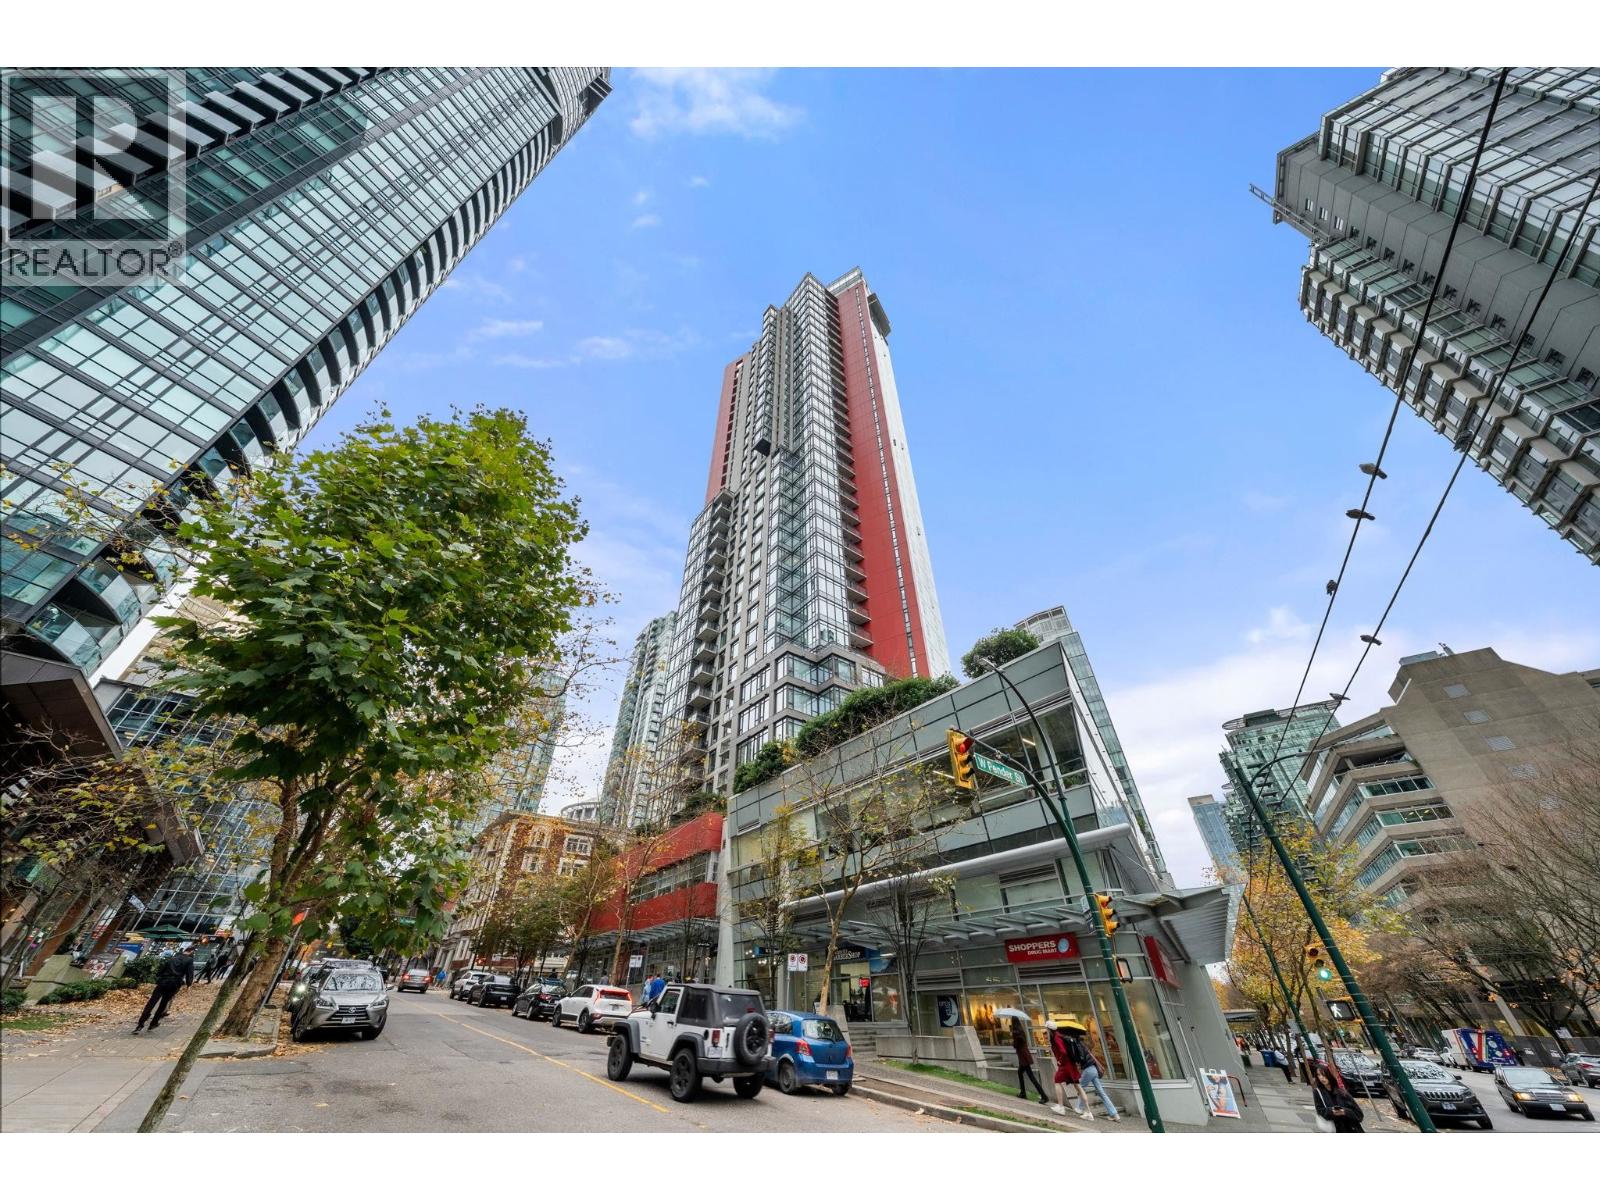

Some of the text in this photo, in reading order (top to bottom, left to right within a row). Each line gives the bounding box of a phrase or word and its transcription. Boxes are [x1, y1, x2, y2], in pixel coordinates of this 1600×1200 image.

[977, 756, 986, 769] W
[987, 760, 1013, 780] Pender
[1008, 940, 1057, 952] SHOPPERS
